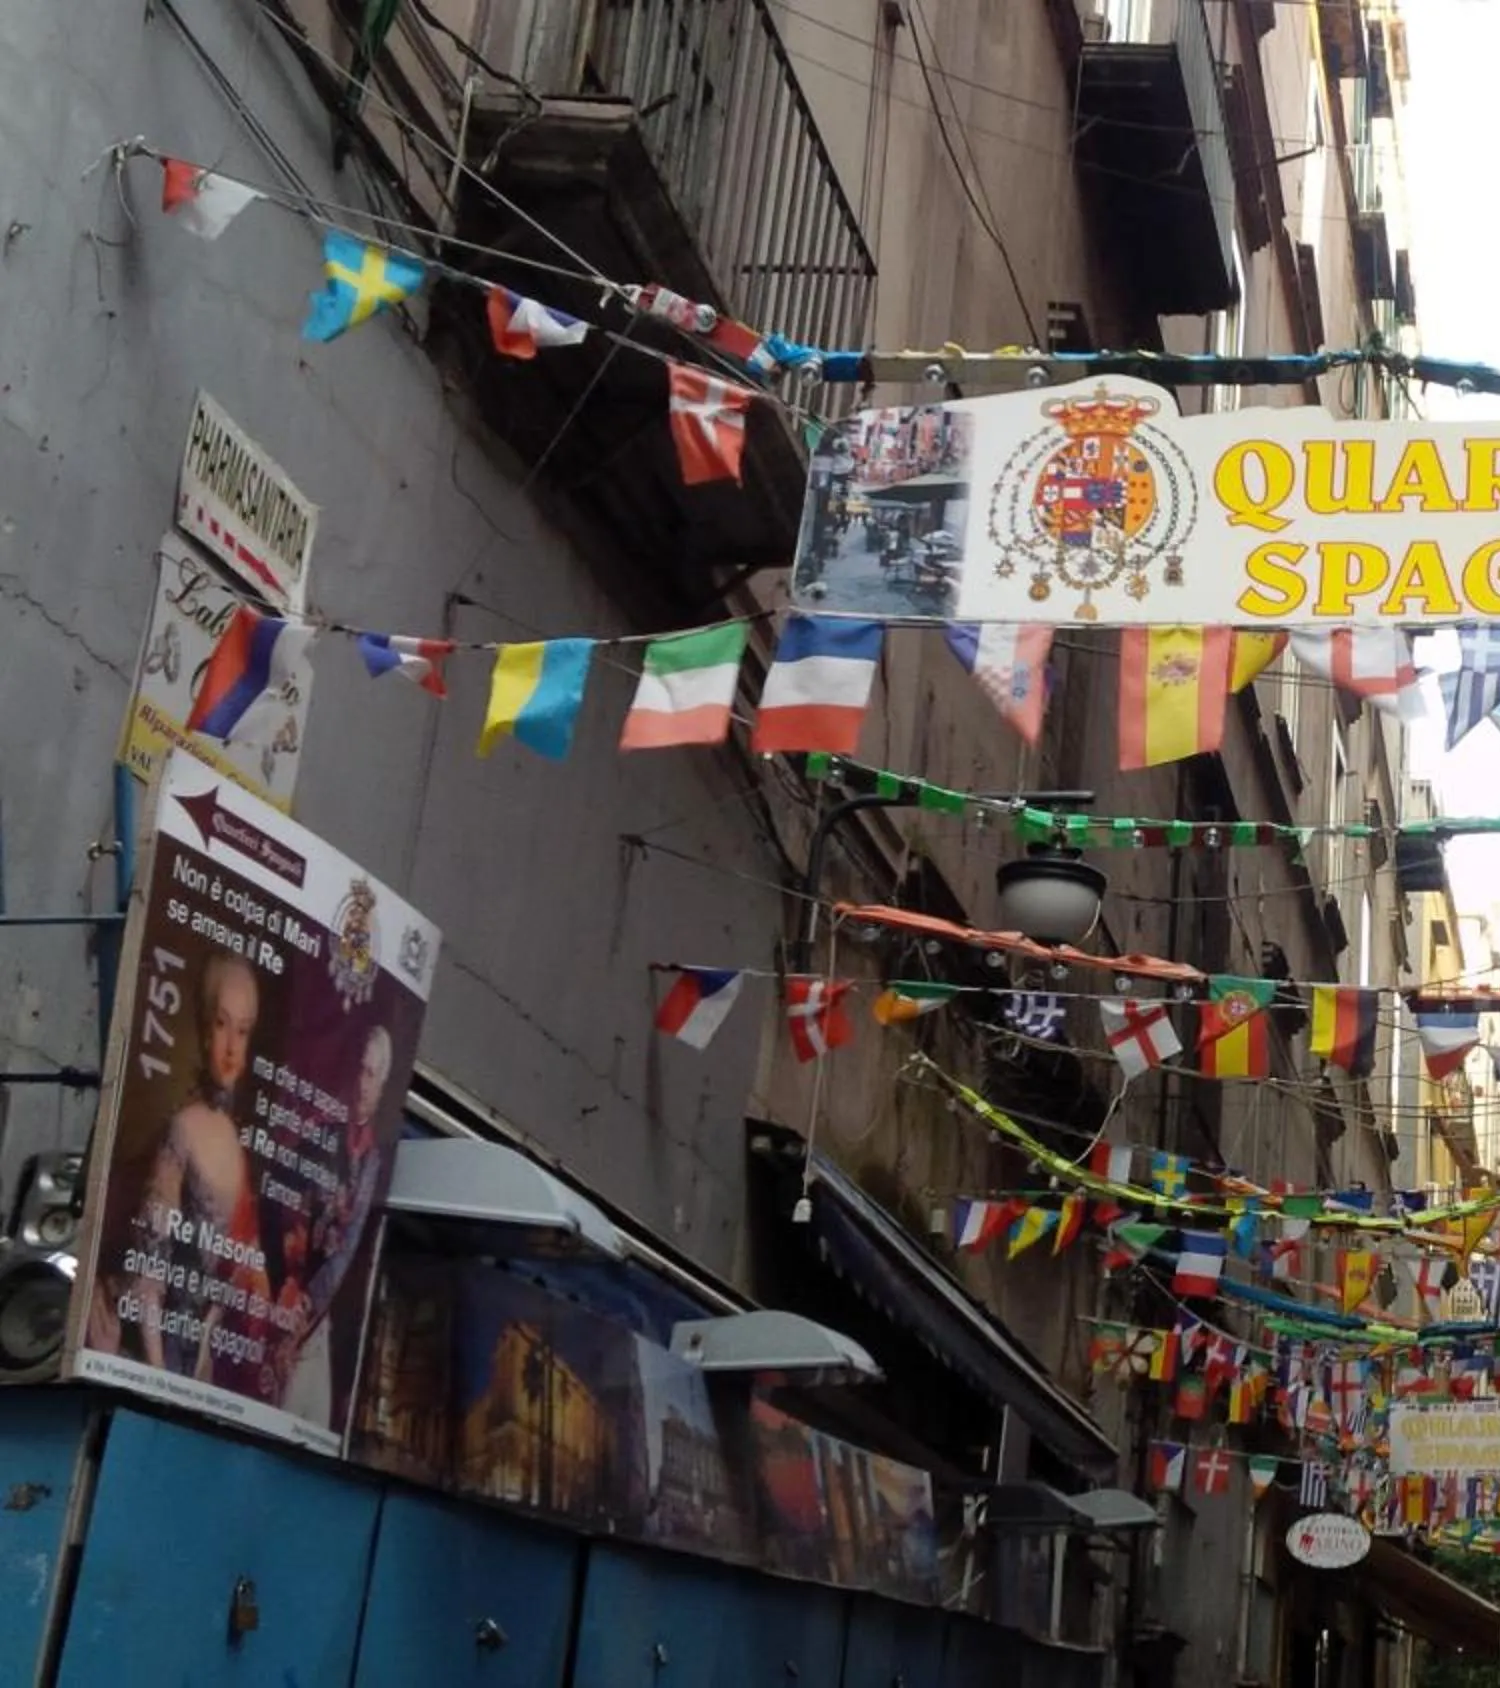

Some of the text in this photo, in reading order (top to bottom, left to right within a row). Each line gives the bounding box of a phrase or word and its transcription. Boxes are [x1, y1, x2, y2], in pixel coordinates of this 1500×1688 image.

[167, 899, 189, 924] se
[191, 910, 244, 953] amava
[258, 942, 284, 975] Re
[173, 854, 207, 893] Non
[225, 889, 266, 925] colpa
[284, 916, 321, 958] Mari
[140, 946, 186, 1080] 1751
[254, 1128, 276, 1159] Re
[124, 1248, 186, 1289] andava
[166, 1209, 193, 1243] Re
[198, 1221, 266, 1271] Nasone
